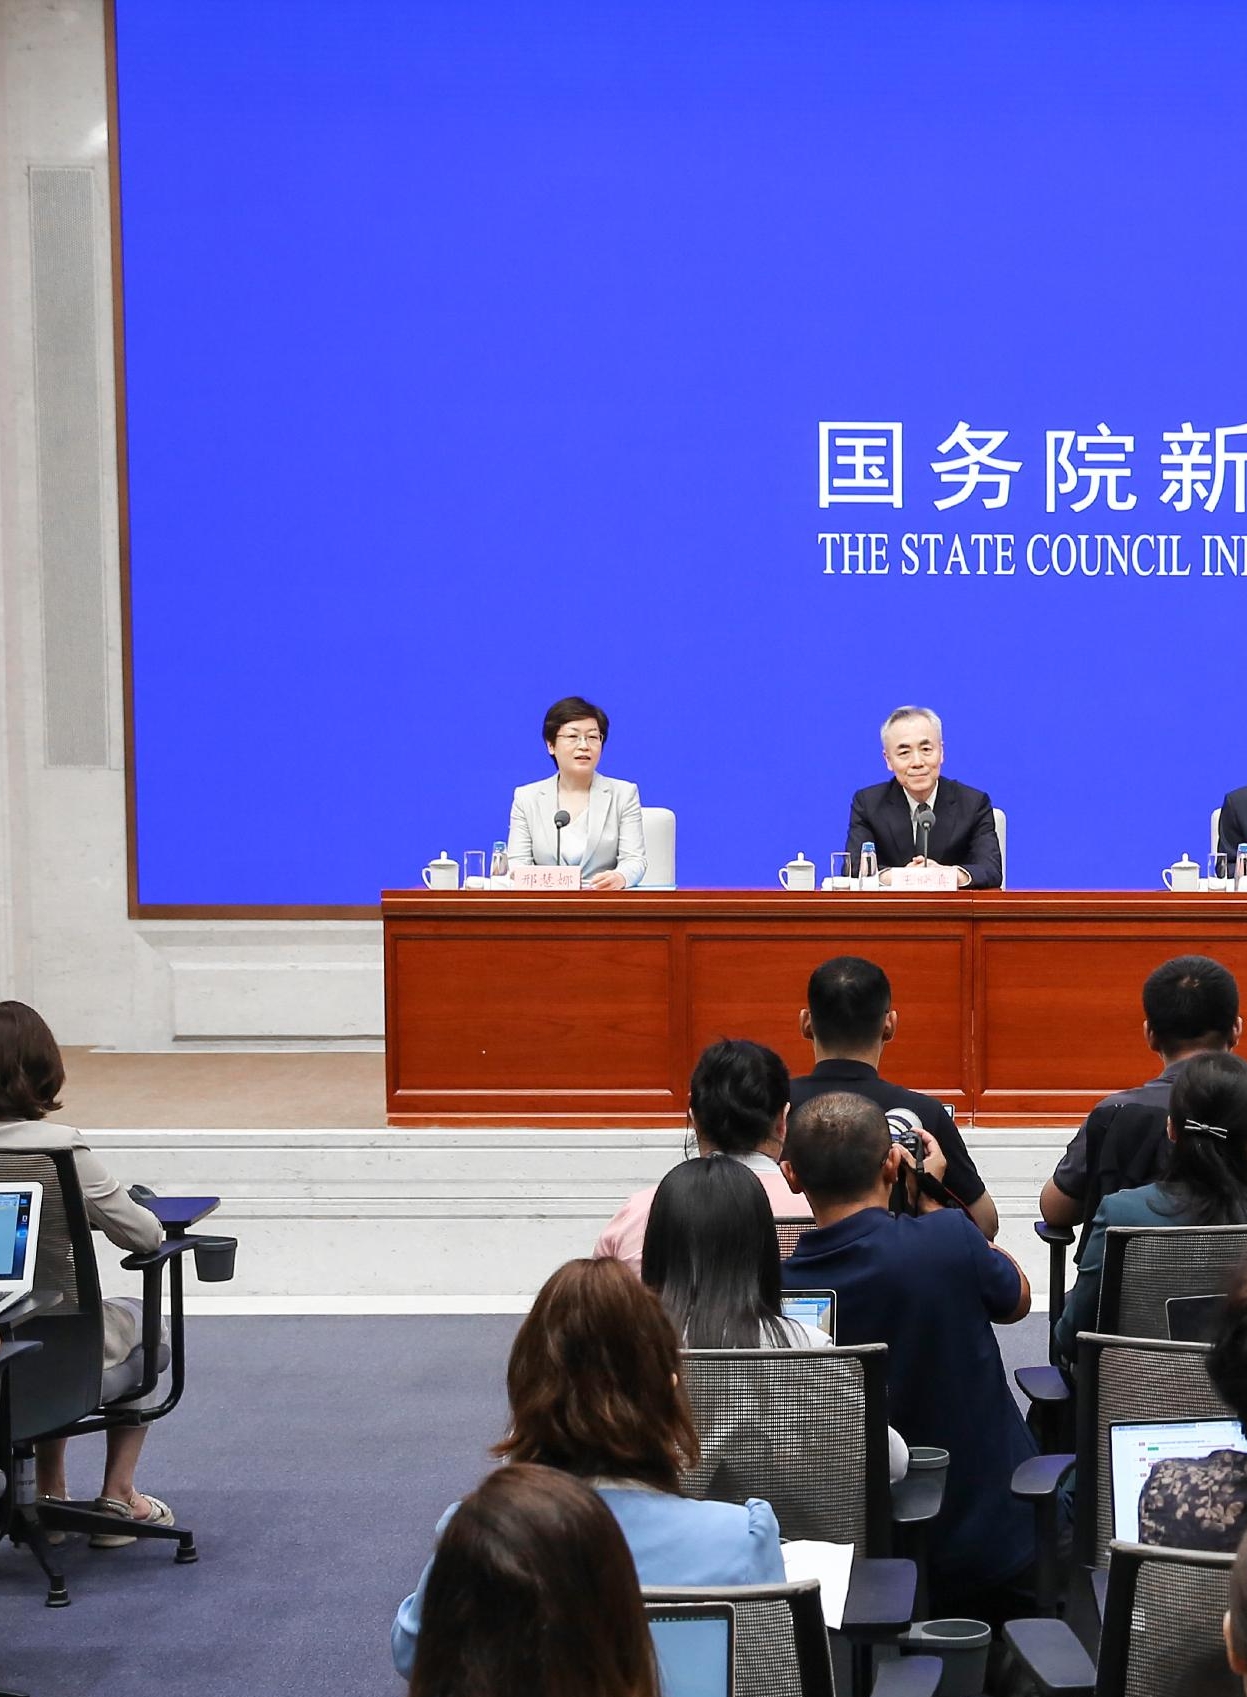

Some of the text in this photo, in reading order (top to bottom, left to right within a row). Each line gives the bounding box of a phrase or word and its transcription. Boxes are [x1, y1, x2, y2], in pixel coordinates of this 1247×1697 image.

[817, 533, 890, 575] THE
[901, 533, 1016, 575] STATE
[1026, 533, 1191, 576] COUNCIL
